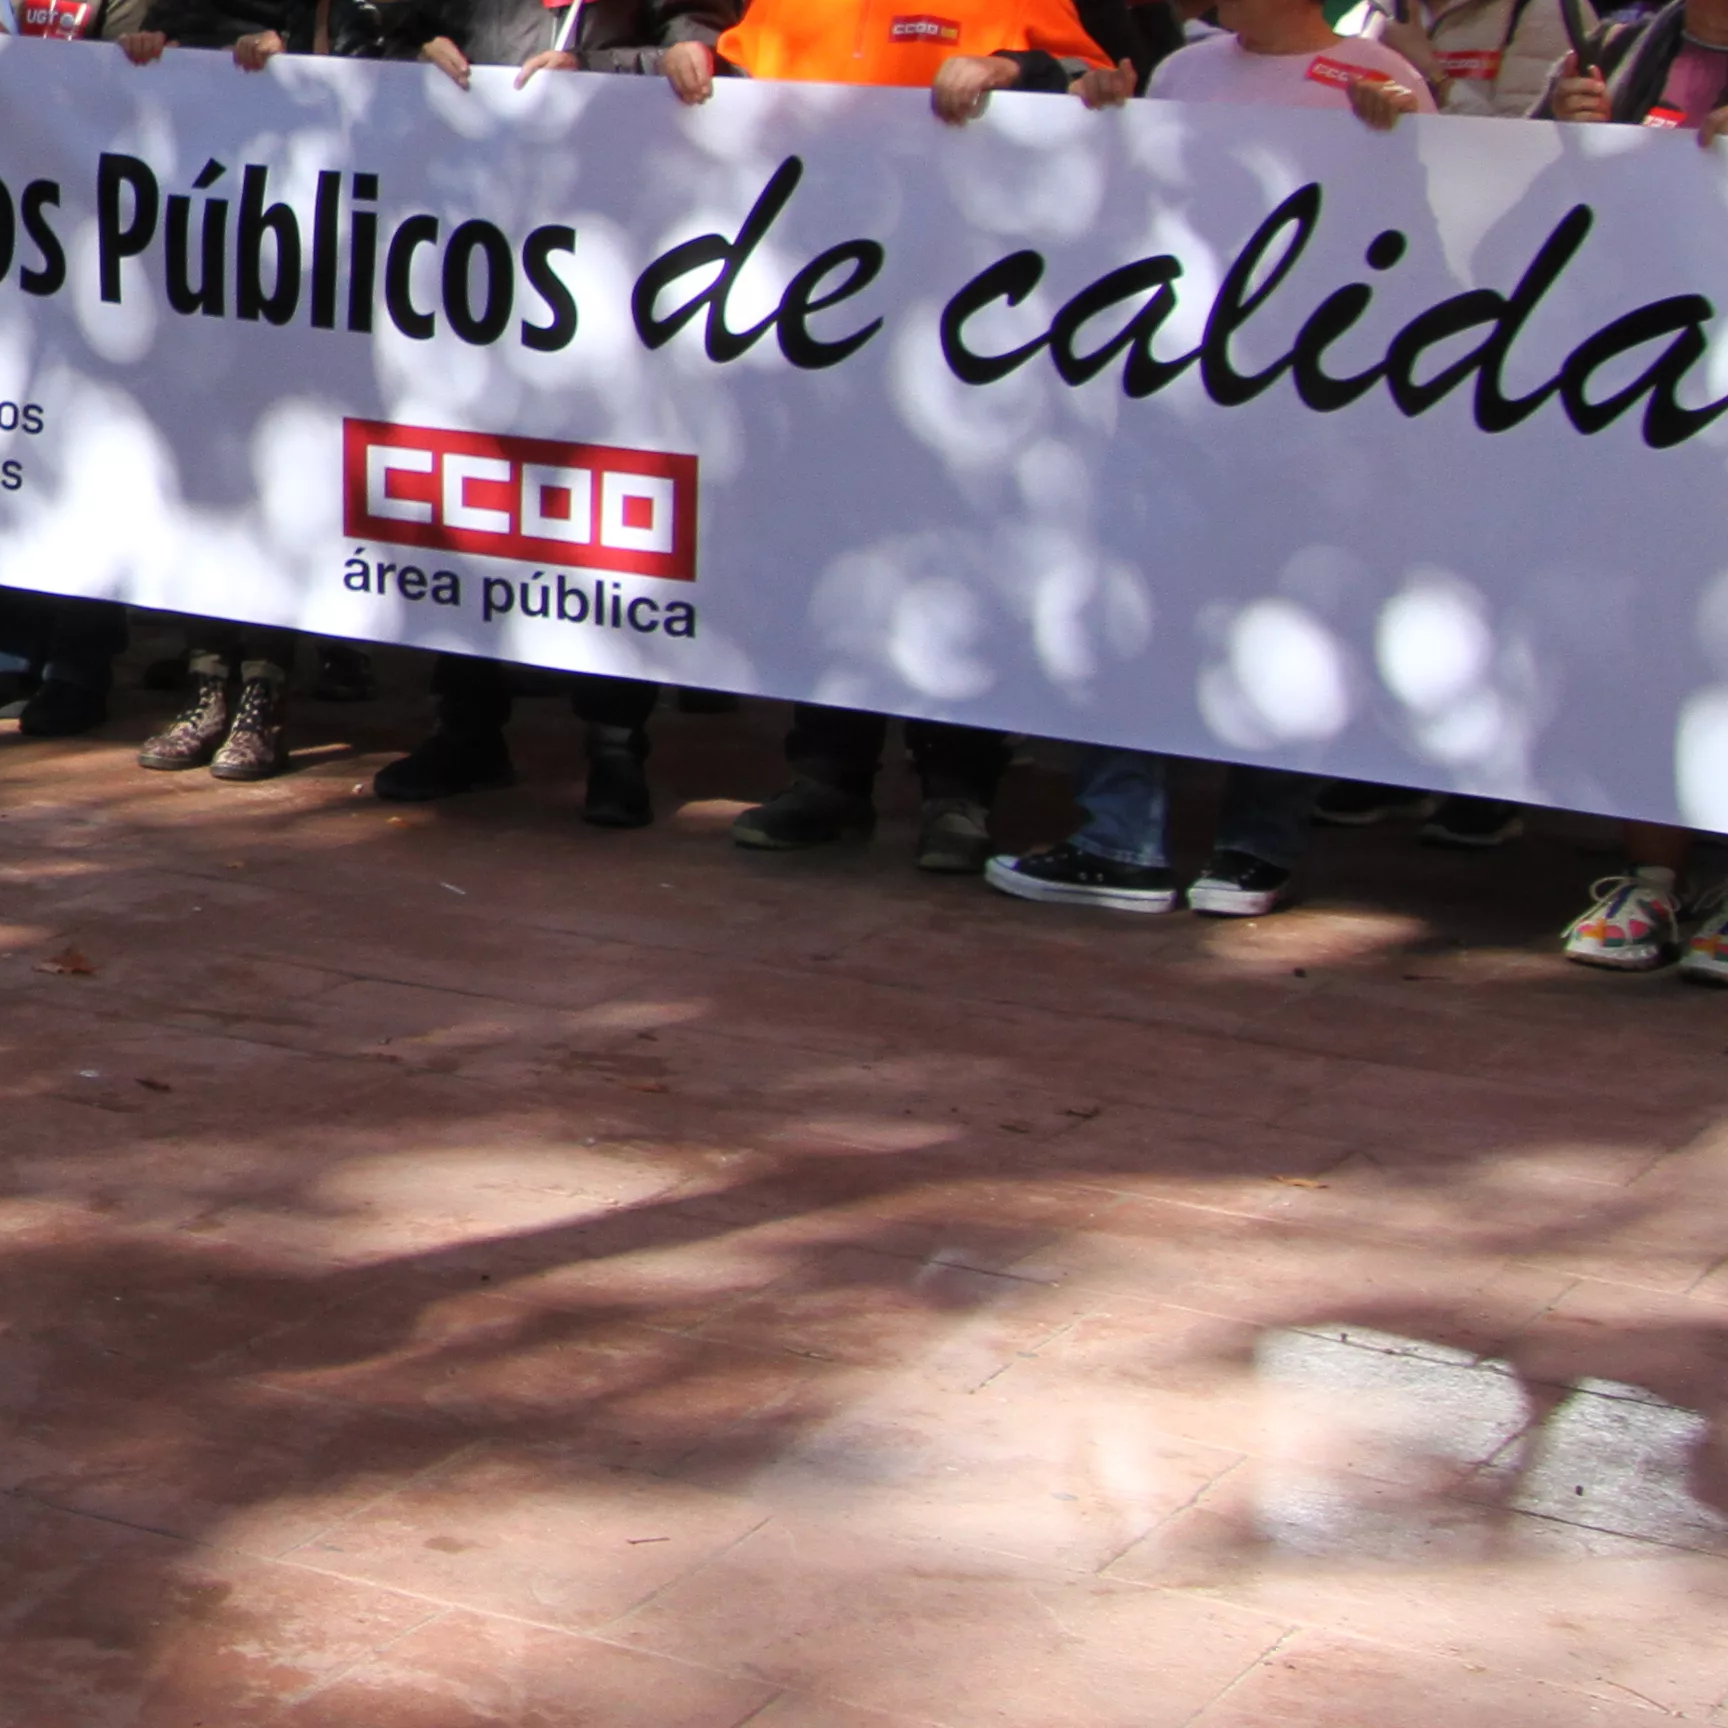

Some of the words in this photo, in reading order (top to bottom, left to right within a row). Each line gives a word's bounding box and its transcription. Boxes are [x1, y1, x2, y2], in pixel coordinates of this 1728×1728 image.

[27, 8, 58, 24] UGT
[97, 153, 580, 351] Públicos
[631, 155, 886, 369] de
[940, 181, 1728, 449] calida
[366, 446, 675, 556] CCOO
[344, 549, 462, 607] área
[482, 568, 697, 638] pública
